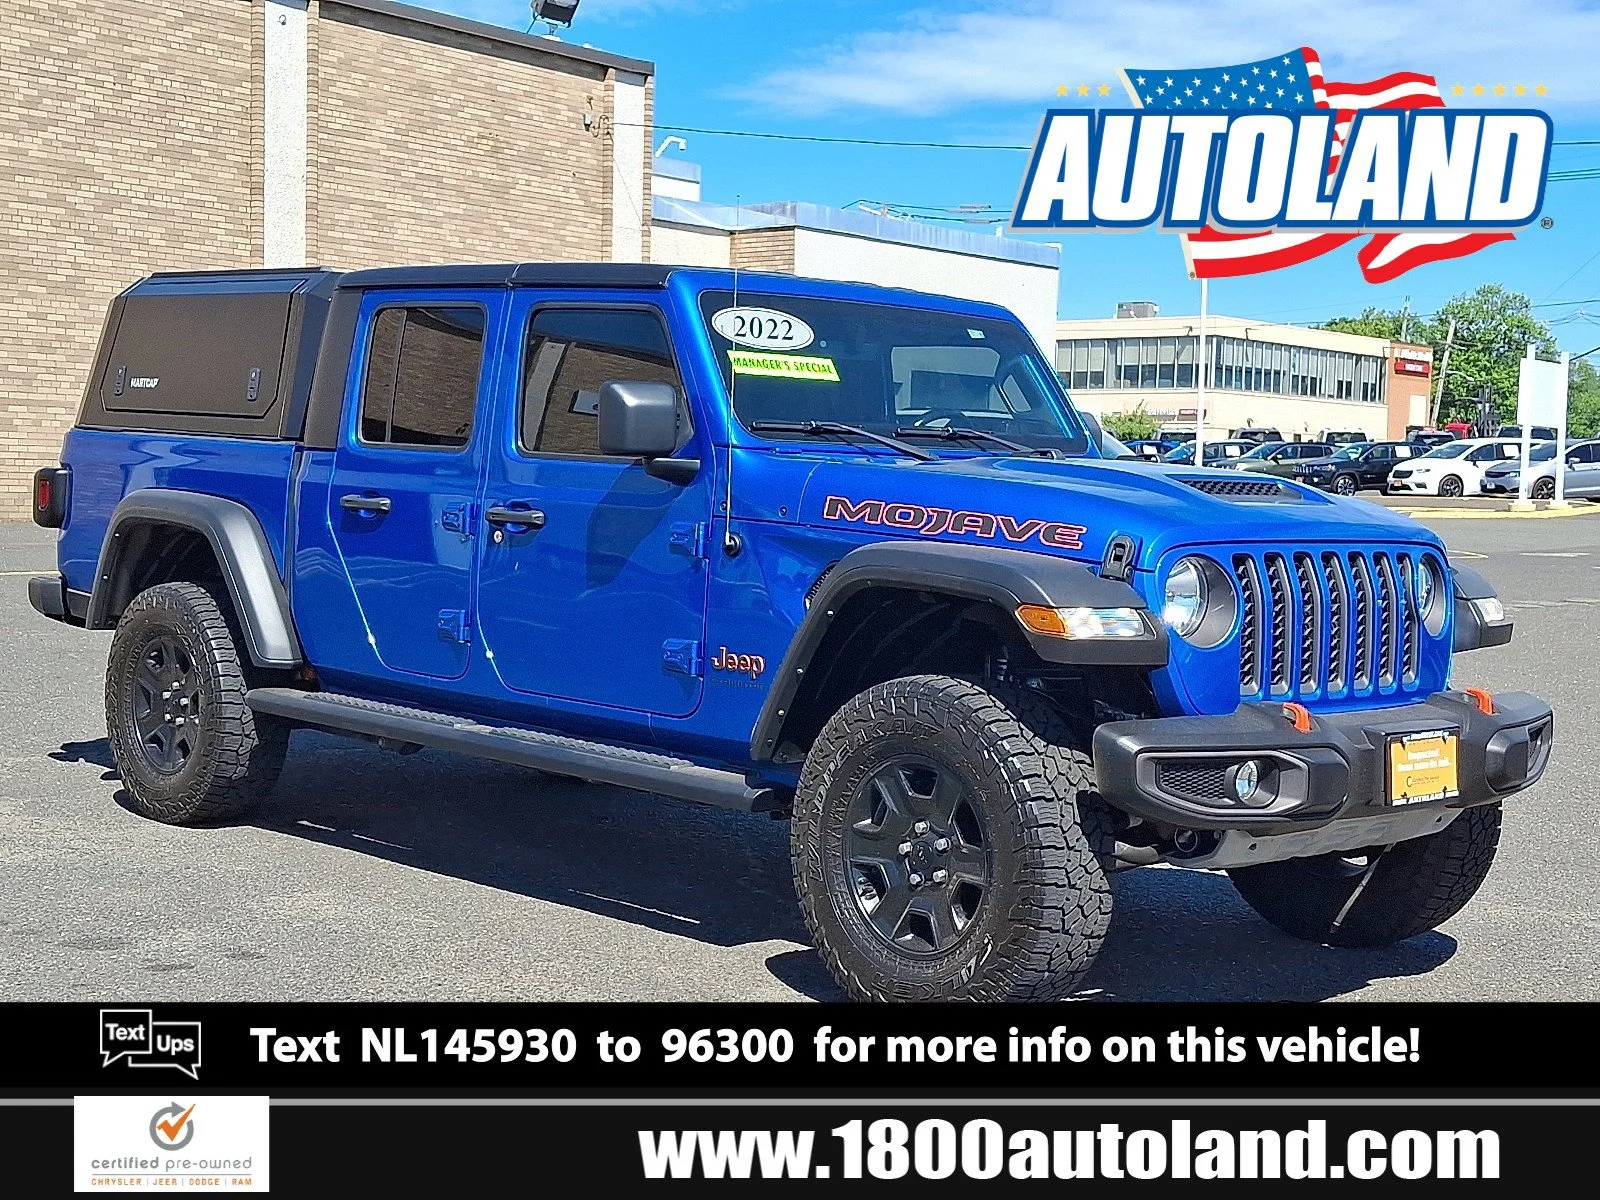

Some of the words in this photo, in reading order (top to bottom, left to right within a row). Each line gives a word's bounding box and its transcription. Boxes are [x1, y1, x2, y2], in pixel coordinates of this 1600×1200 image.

[733, 315, 794, 341] 2022
[733, 356, 791, 372] MANAGER'S
[793, 361, 835, 375] SPECIAL
[823, 495, 1088, 551] MOJAVE
[711, 645, 766, 681] Jeep
